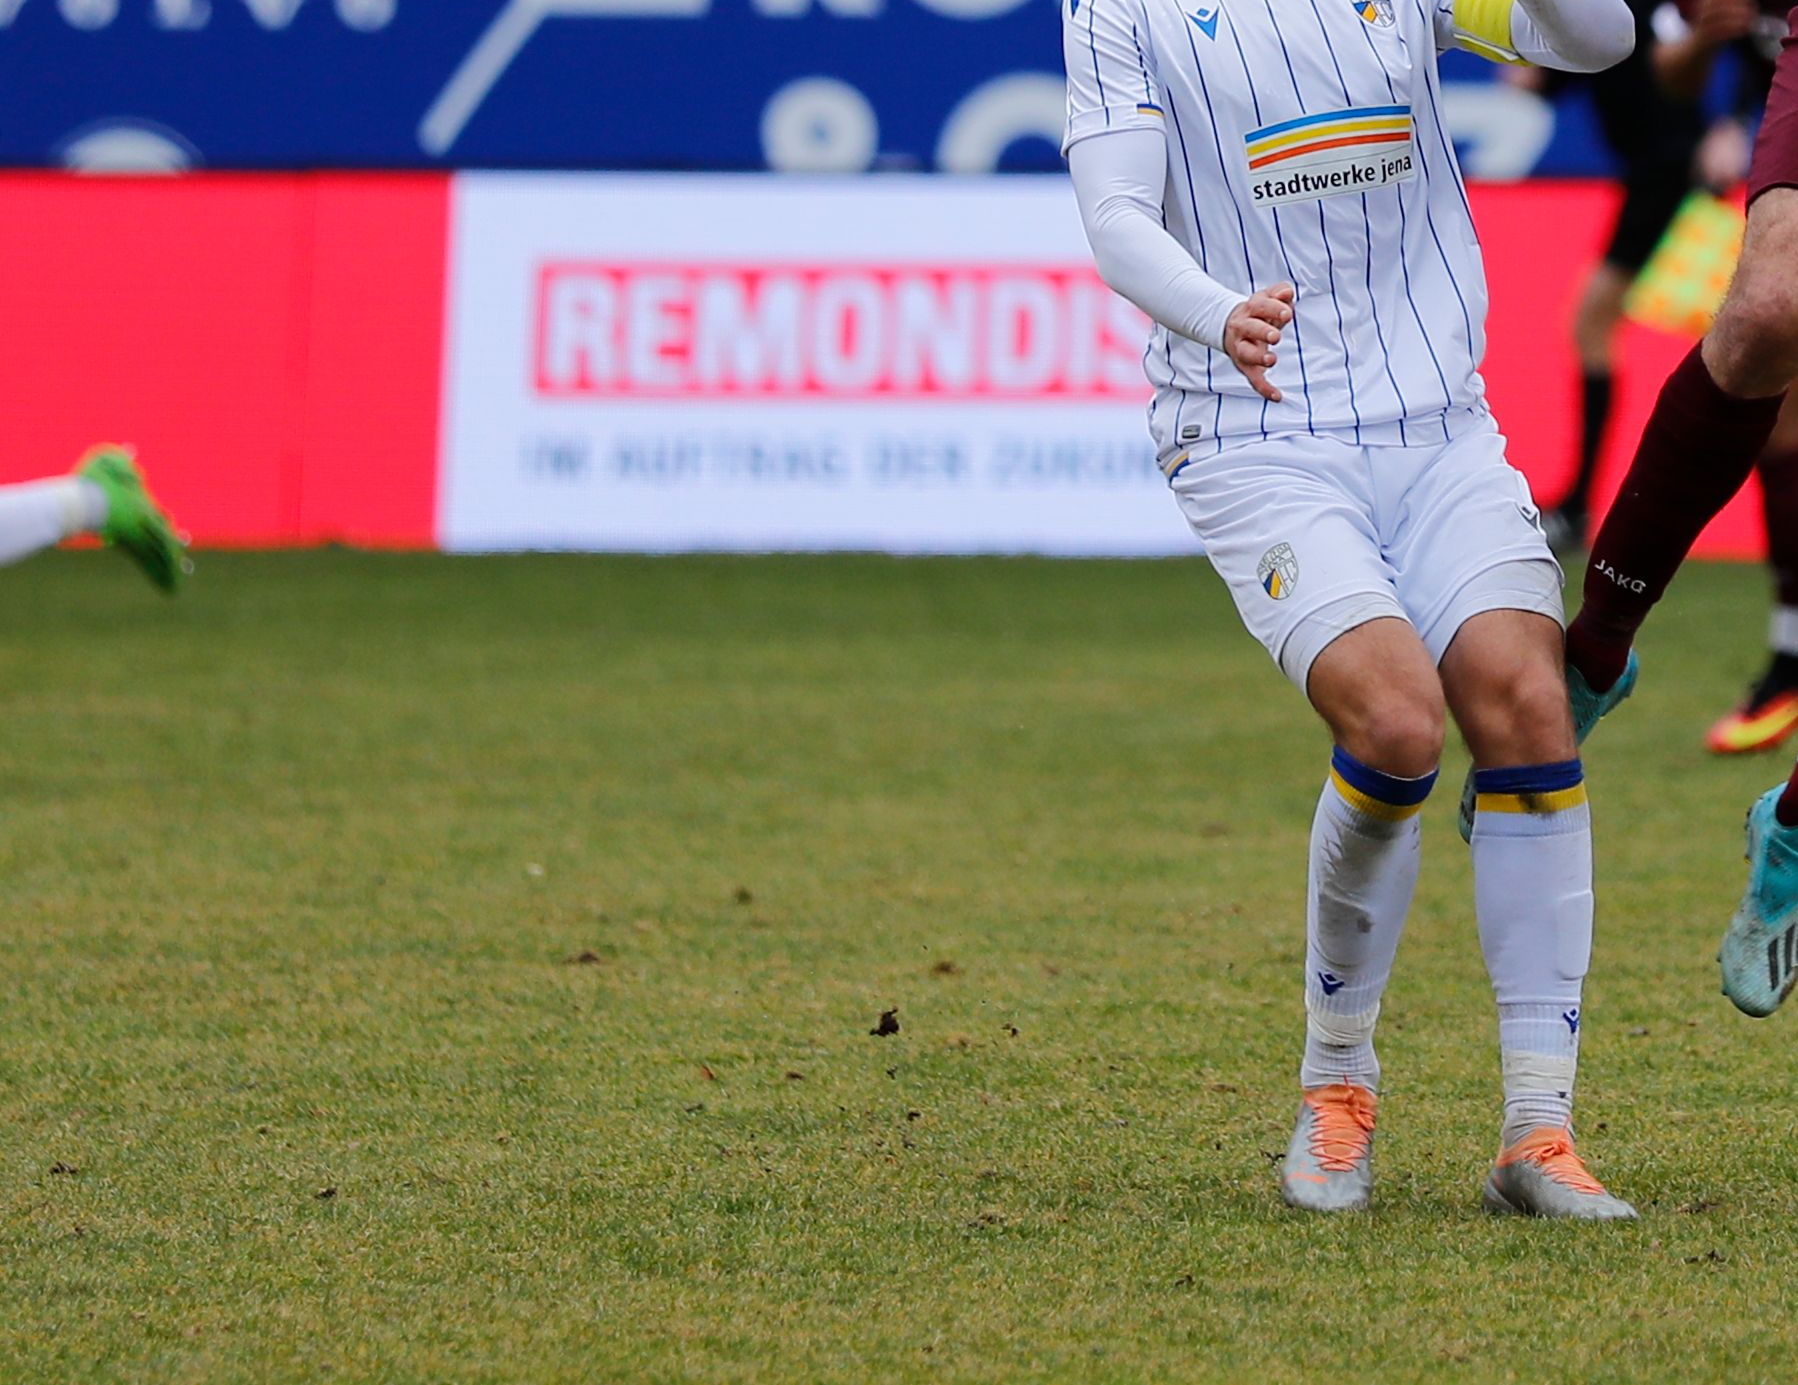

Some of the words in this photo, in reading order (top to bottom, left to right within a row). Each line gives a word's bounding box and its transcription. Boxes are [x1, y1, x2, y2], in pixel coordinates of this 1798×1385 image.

[1253, 164, 1376, 200] stadtwerke
[1380, 156, 1412, 183] jena
[544, 271, 1153, 394] REMONDIS
[1594, 559, 1646, 594] JAKO
